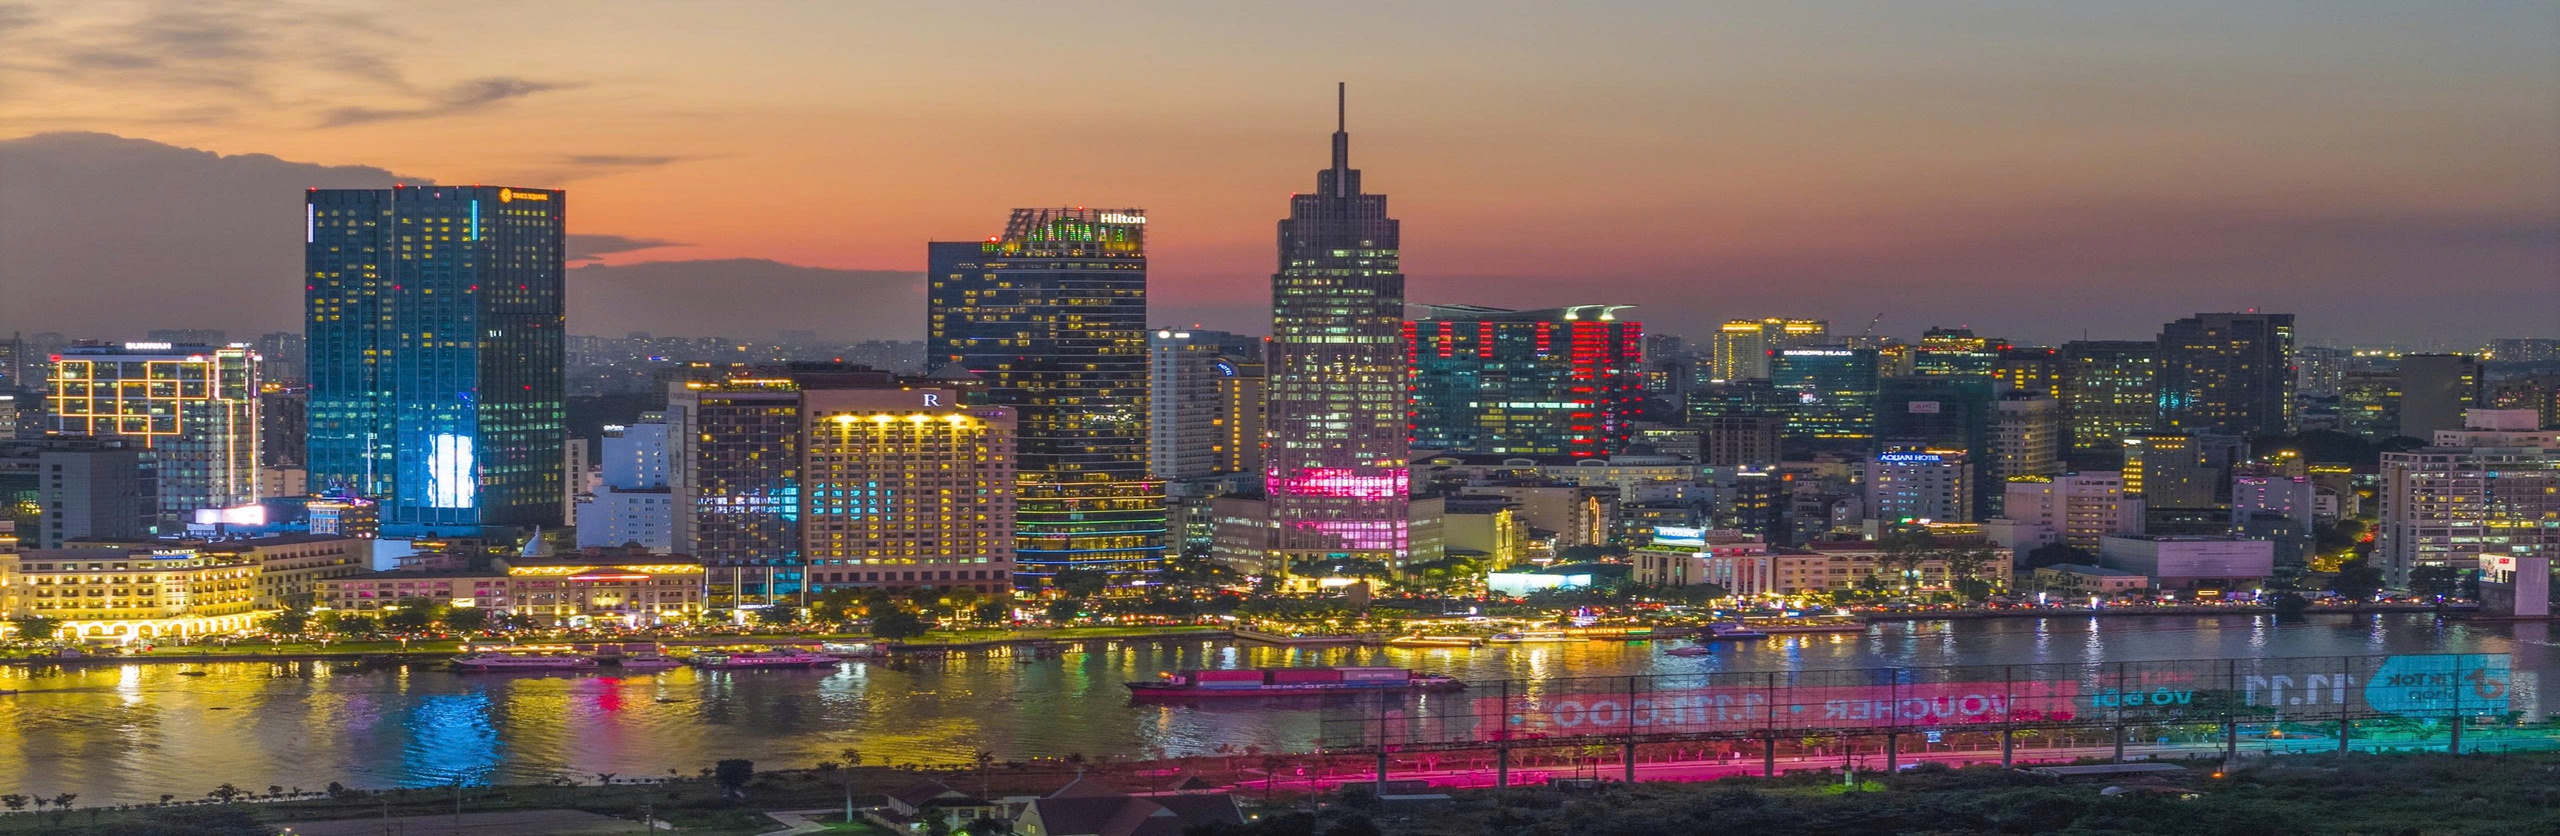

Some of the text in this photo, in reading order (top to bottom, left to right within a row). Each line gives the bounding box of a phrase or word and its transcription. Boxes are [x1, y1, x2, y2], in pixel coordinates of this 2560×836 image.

[528, 193, 548, 201] SQUARE
[1100, 213, 1146, 224] Hilton
[125, 342, 171, 350] SUNWAH
[1217, 363, 1232, 376] HOTEL
[923, 394, 943, 406] R
[1659, 528, 1699, 538] HYOSUNG
